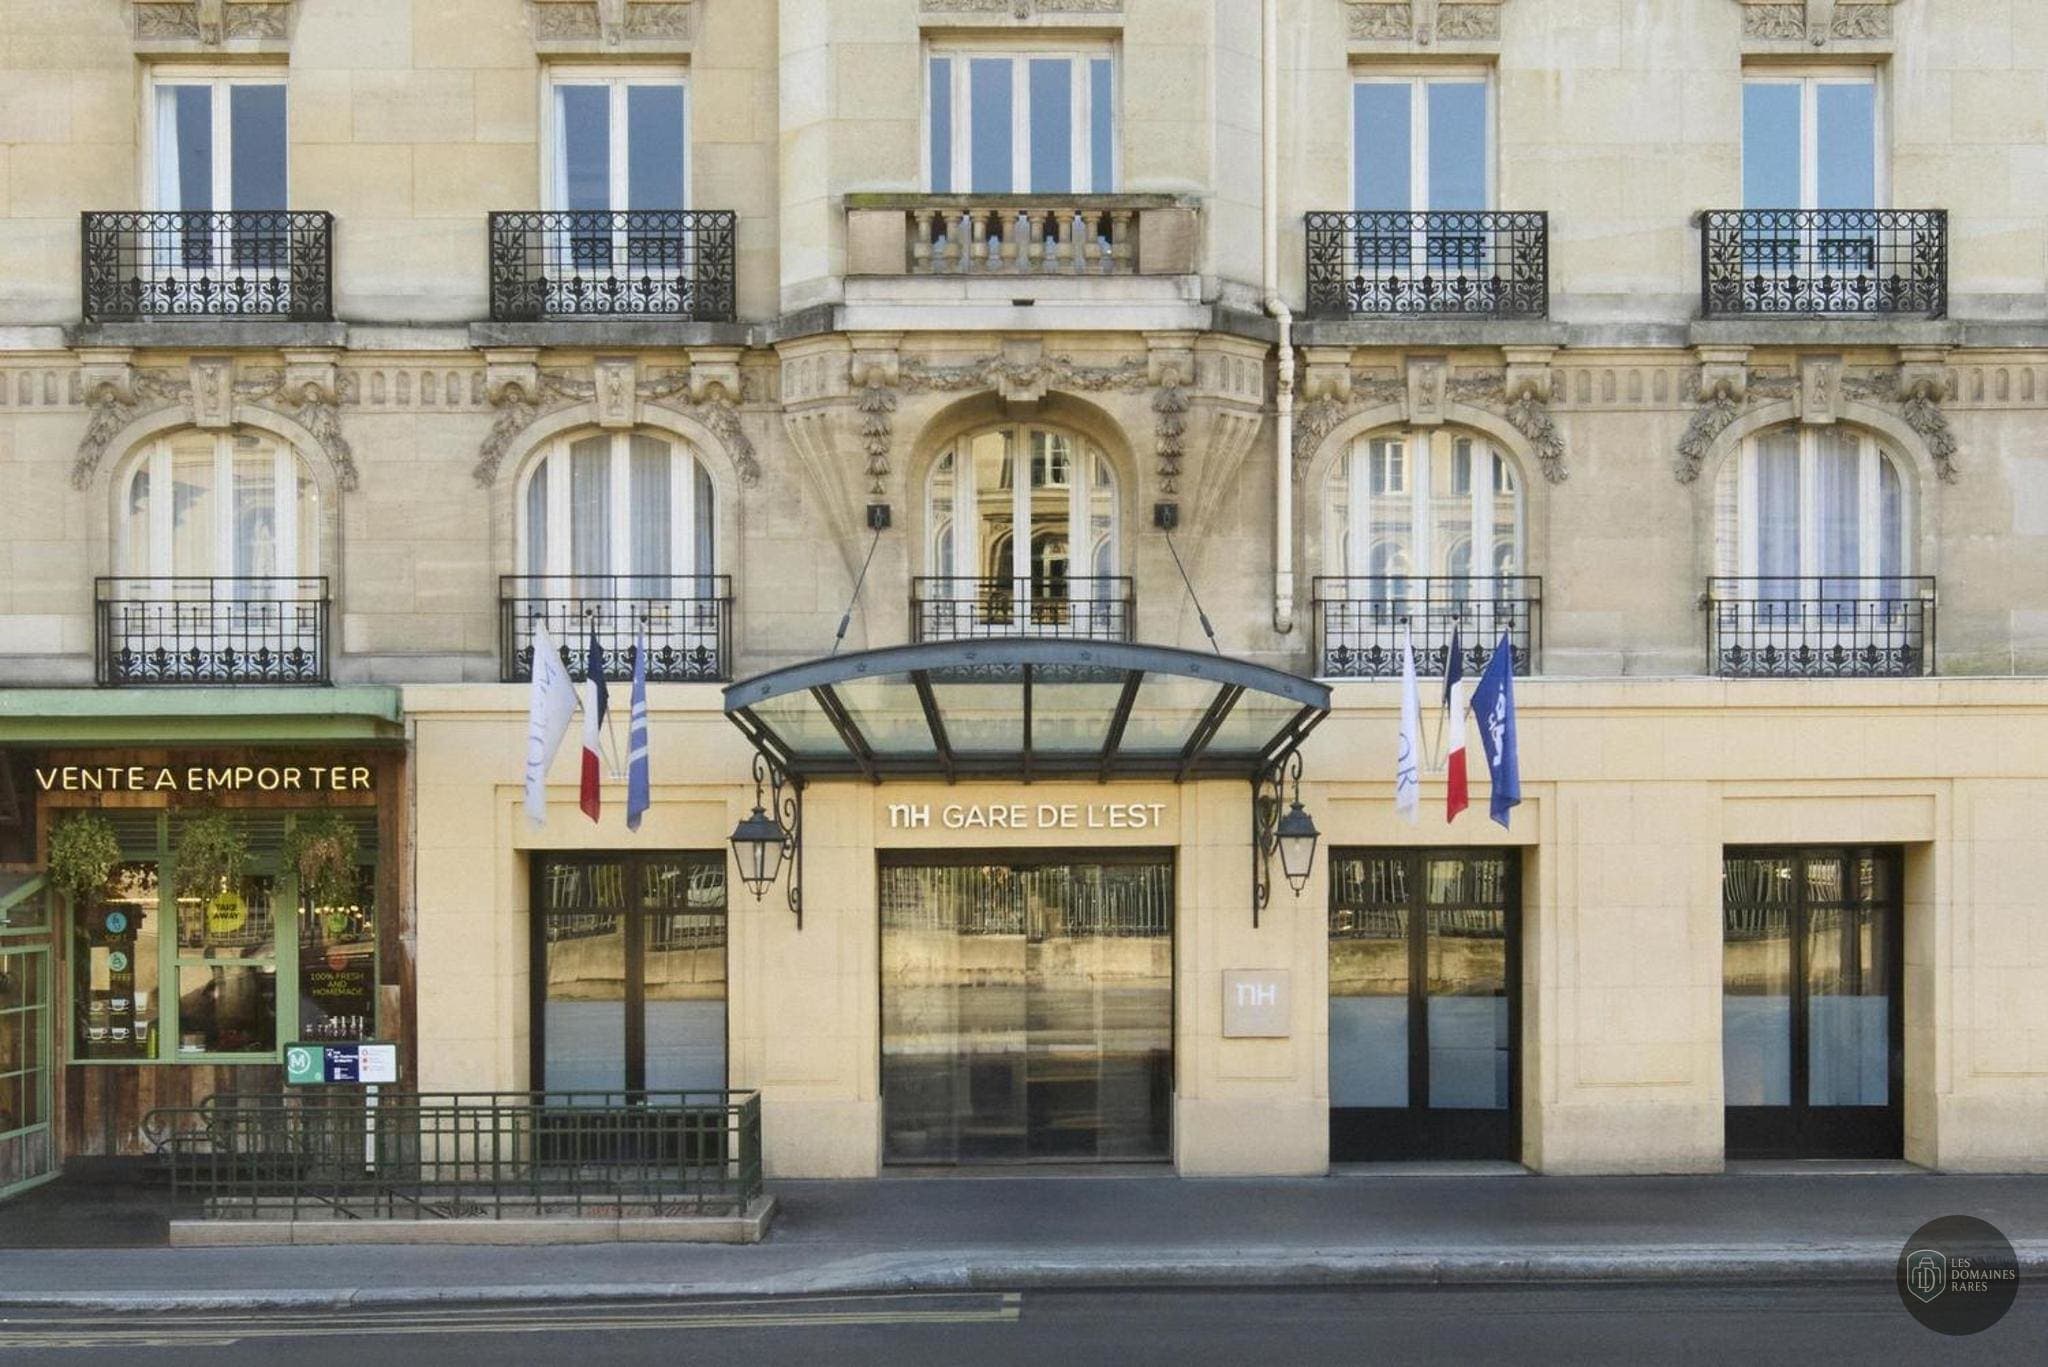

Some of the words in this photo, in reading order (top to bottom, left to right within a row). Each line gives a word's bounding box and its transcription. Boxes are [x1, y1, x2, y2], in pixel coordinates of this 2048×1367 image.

[36, 767, 144, 790] VENTE
[154, 768, 177, 790] A
[187, 767, 370, 791] EMPORTER
[943, 804, 1028, 828] GARE
[1037, 804, 1079, 828] DE
[1087, 804, 1167, 828] L'EST
[213, 911, 240, 920] AWAY
